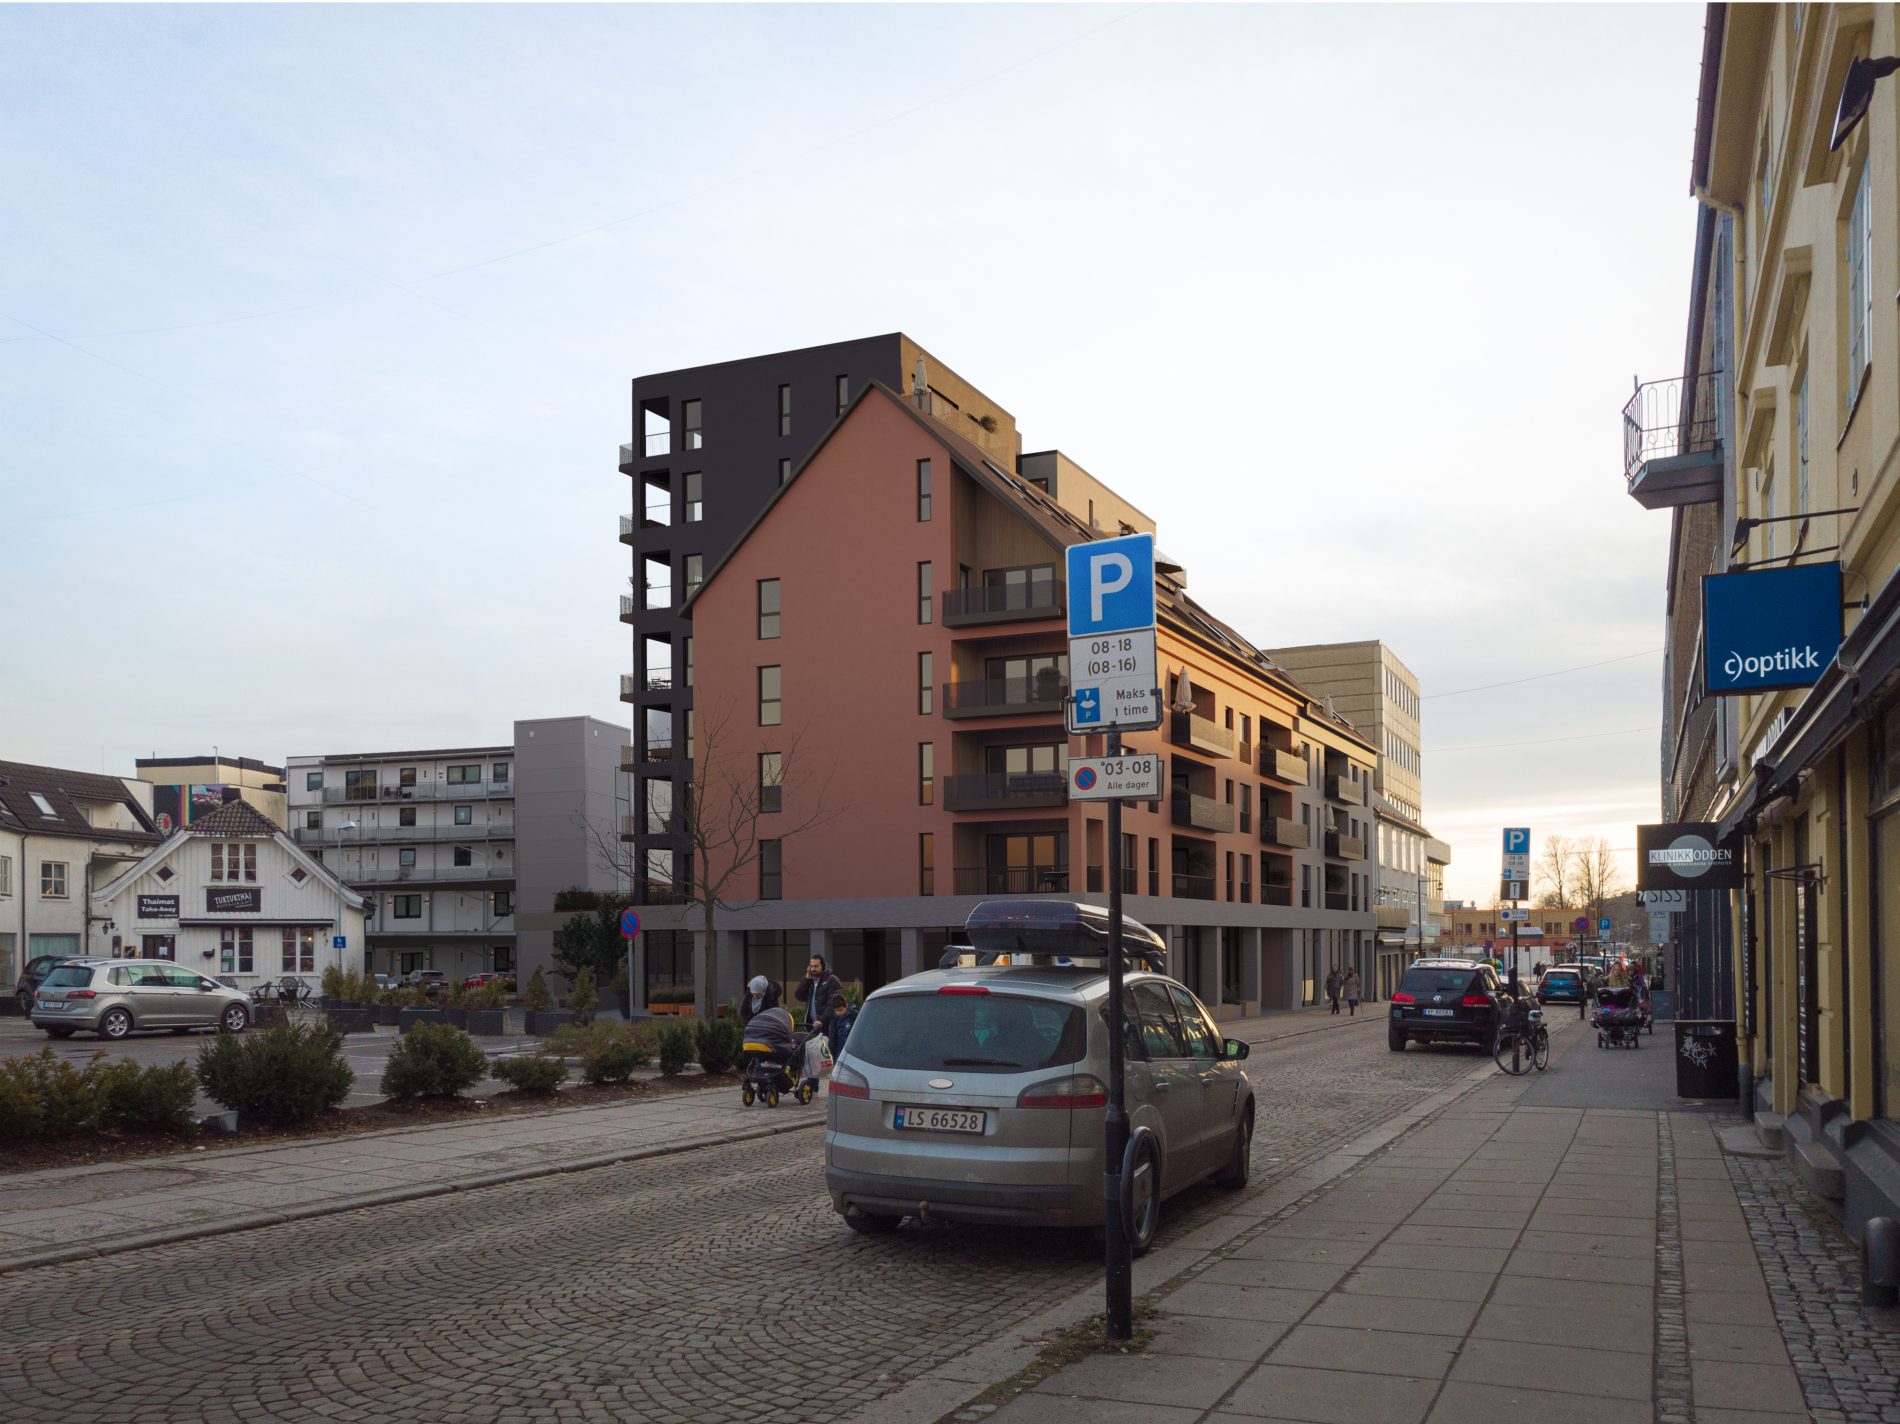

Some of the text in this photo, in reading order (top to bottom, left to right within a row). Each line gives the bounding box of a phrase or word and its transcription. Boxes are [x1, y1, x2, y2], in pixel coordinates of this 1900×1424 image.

[1090, 552, 1133, 622] P
[1091, 638, 1132, 655] 08-18
[1088, 656, 1136, 676] (08-16)
[1116, 689, 1145, 701] Maks
[1085, 710, 1091, 720] P
[1114, 704, 1148, 717] 1 time
[1105, 760, 1151, 776] 03-08
[1107, 780, 1150, 791] Alle dager
[1509, 831, 1525, 851] P
[1602, 920, 1608, 929] P
[907, 1110, 978, 1130] LS 66528
